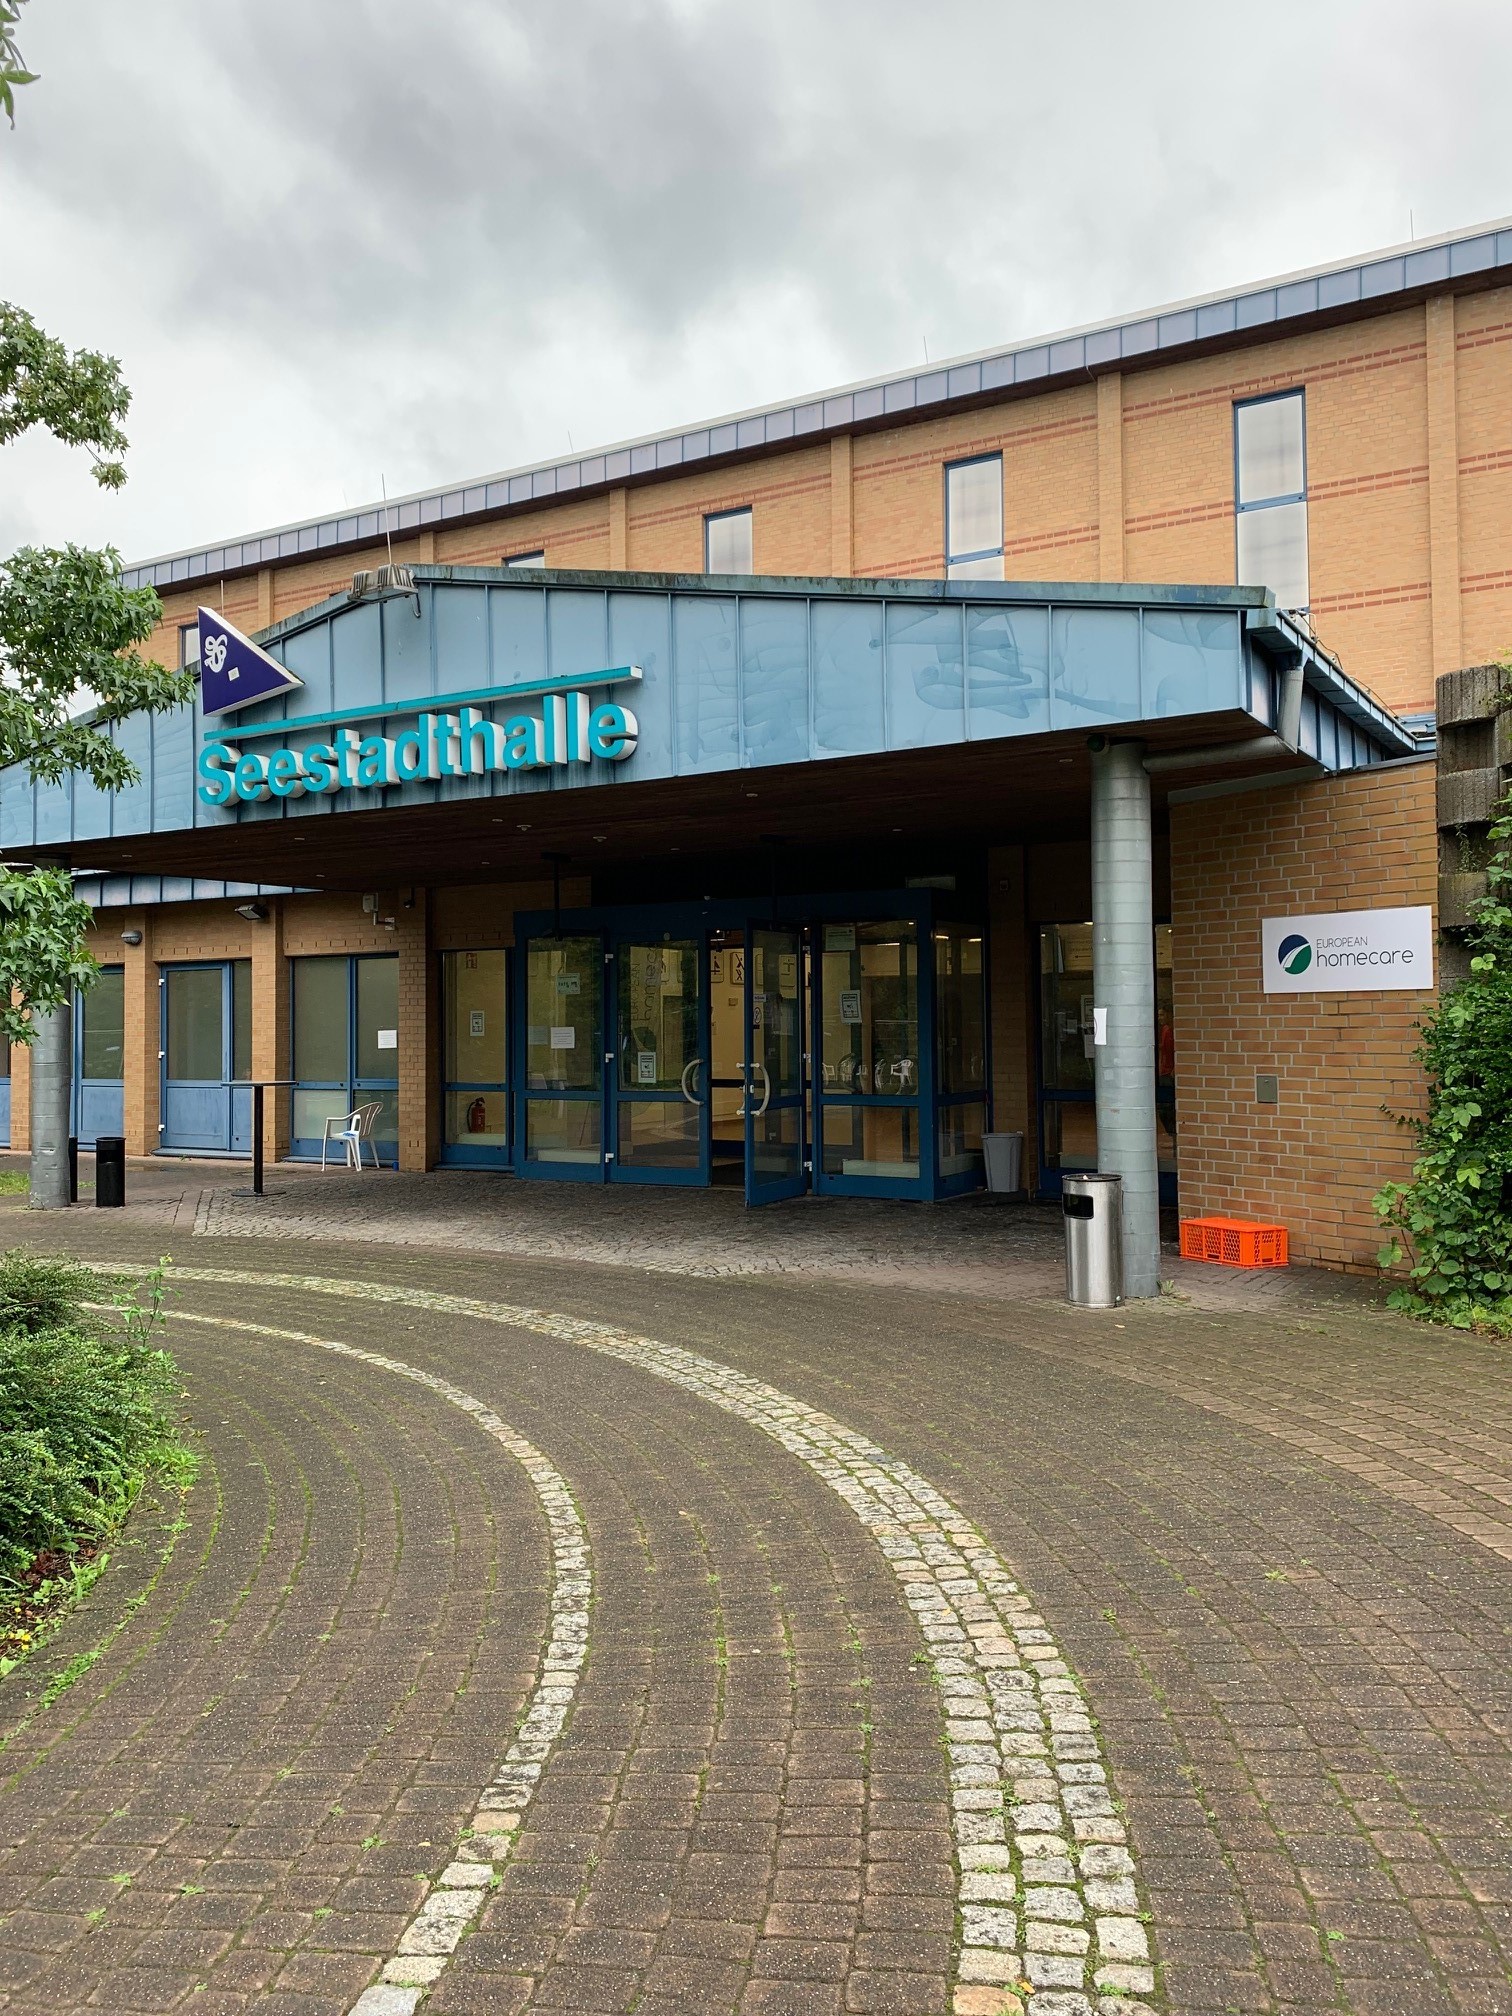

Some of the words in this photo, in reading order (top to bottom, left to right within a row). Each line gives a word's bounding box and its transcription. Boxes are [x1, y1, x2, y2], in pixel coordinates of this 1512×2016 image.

[198, 691, 637, 806] Seestadthalle
[1316, 936, 1369, 949] EUROPEAN
[1316, 949, 1414, 968] homecare
